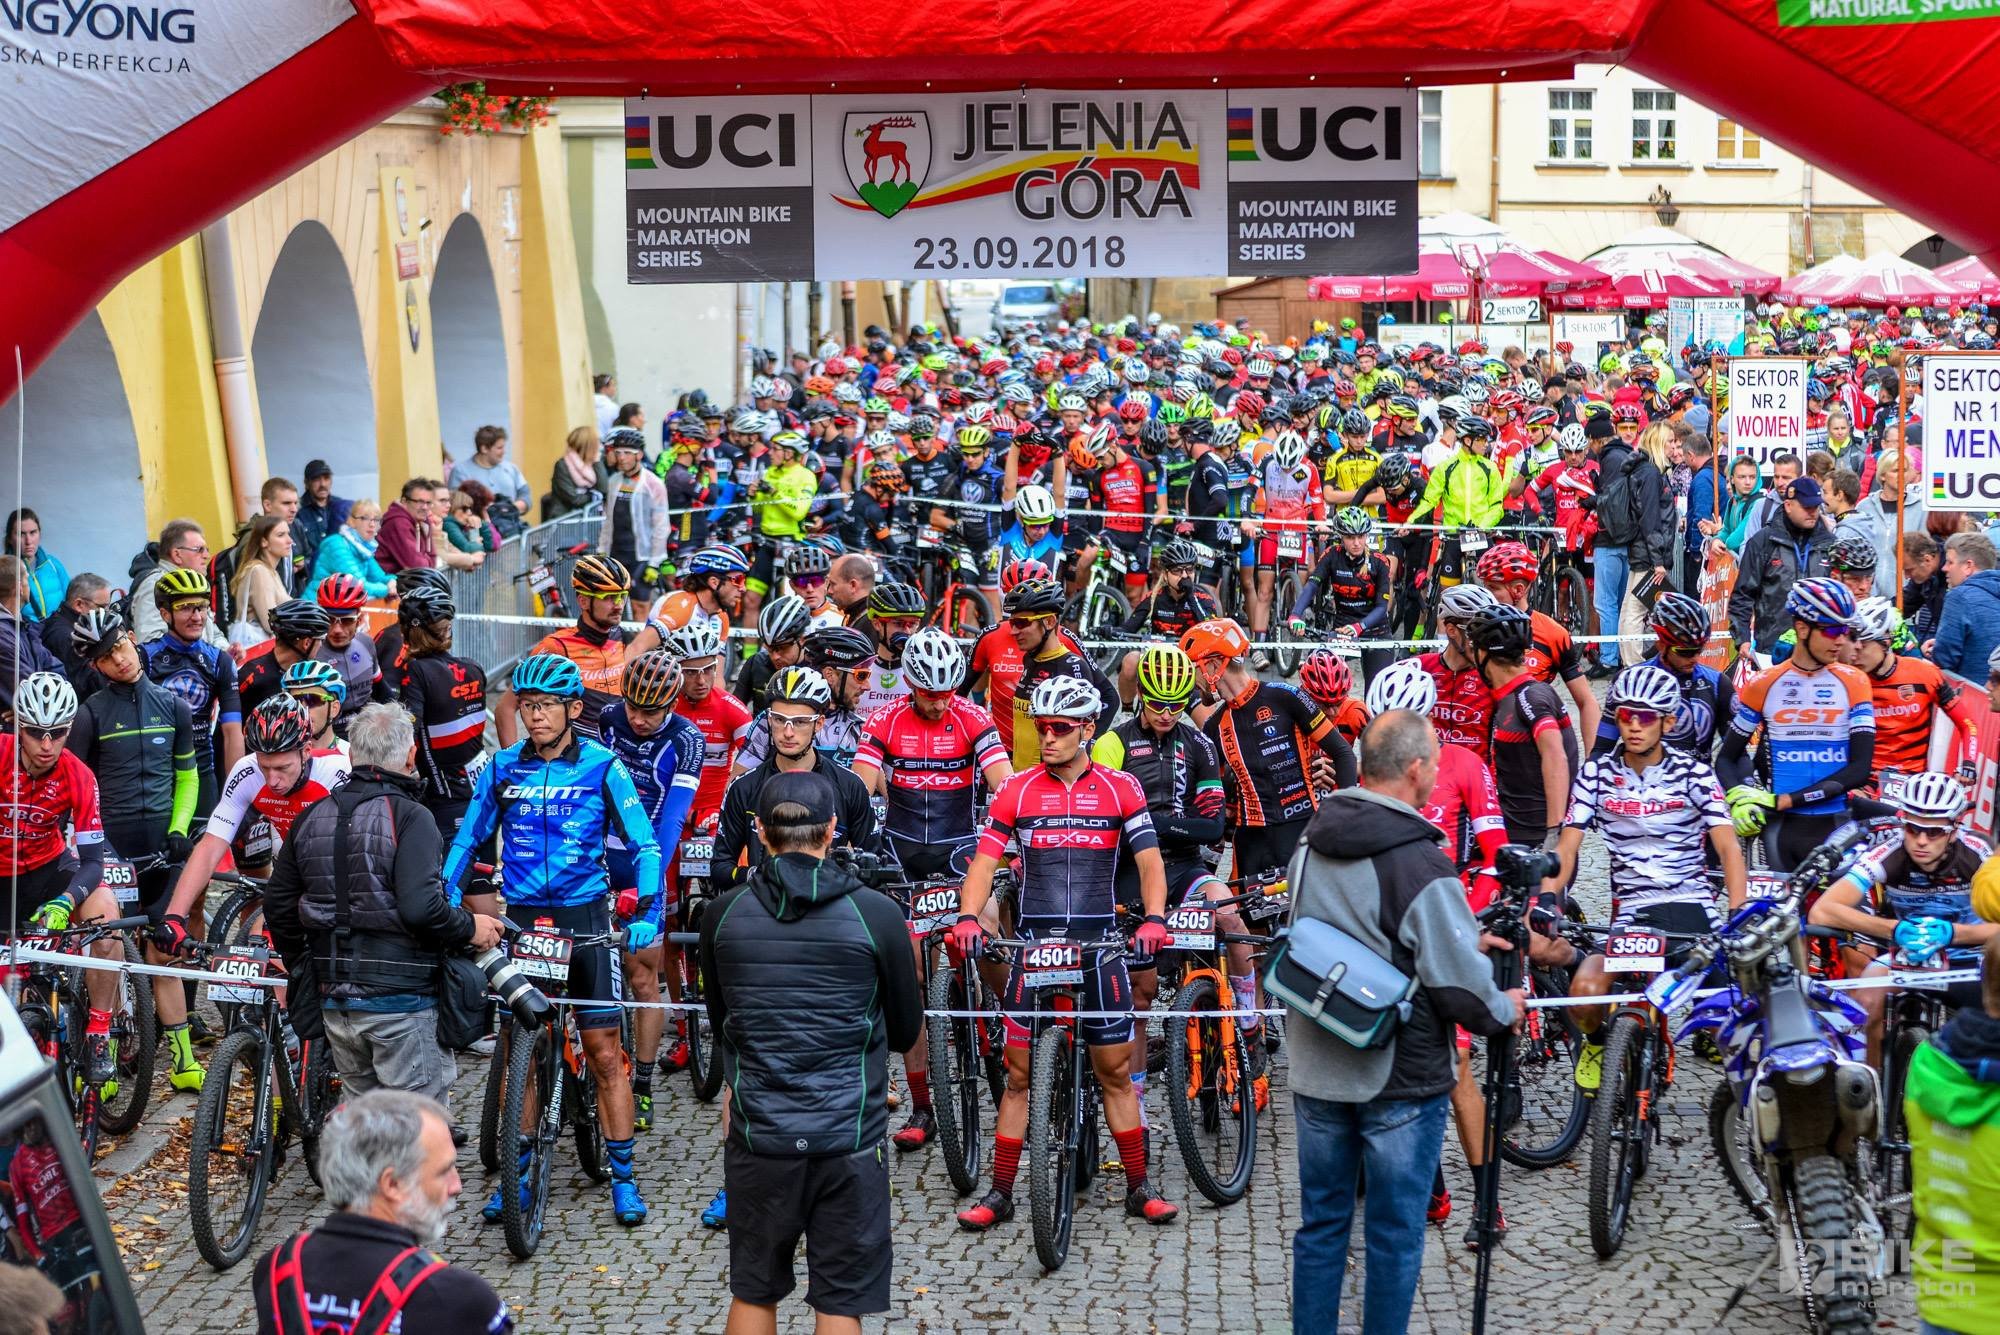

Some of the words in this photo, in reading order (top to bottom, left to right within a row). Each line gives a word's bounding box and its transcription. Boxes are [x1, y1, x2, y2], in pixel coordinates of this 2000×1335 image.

[1809, 0, 1914, 19] NATURAL
[57, 51, 191, 73] PERFEKCJA
[953, 101, 1192, 161] JELENIA
[1262, 106, 1402, 162] UCI
[658, 113, 796, 169] UCI
[1014, 156, 1192, 220] GÓRA
[637, 207, 743, 224] MOUNTAIN
[749, 206, 791, 223] BIKE
[1239, 201, 1348, 218] MOUNTAIN
[1354, 200, 1397, 217] BIKE
[637, 228, 751, 246] MARATHON
[1239, 222, 1354, 239] MARATHON
[637, 251, 702, 268] SERIES
[914, 235, 1126, 269] 23.09.2018
[1239, 244, 1306, 261] SERIES
[1434, 285, 1467, 295] WARKA
[1484, 302, 1495, 321] 2
[1497, 306, 1526, 316] SEKTOR
[1528, 300, 1539, 319] 2
[1557, 317, 1567, 339] 1
[1611, 317, 1621, 339] 1
[1737, 369, 1799, 386] SEKTOR
[1752, 394, 1772, 409] NR
[1778, 393, 1786, 409] 2
[1954, 401, 1982, 422] NR
[1990, 401, 1998, 421] 1
[1736, 415, 1799, 437] WOMEN
[1946, 429, 2000, 458] MEN
[1281, 536, 1300, 549] 1753
[451, 681, 480, 698] CST
[1773, 708, 1844, 724] CST
[1222, 726, 1238, 757] TEAM
[1775, 747, 1847, 764] sandd
[904, 760, 966, 770] SIMPLON
[224, 765, 255, 799] mazda
[894, 773, 964, 788] TEXPA
[503, 785, 594, 799] GIANT
[4, 807, 45, 825] JBG
[519, 804, 573, 816] 伊予銀行
[1430, 806, 1443, 823] 2
[1046, 818, 1109, 828] SIMPLON
[1033, 832, 1104, 847] TEXPA
[685, 843, 714, 859] 288
[103, 866, 132, 884] 565
[916, 889, 959, 914] 4502
[1167, 911, 1210, 930] 4505
[520, 934, 565, 958] 3561
[1613, 937, 1659, 954] 3560
[1029, 947, 1074, 967] 4501
[222, 960, 265, 979] 4506
